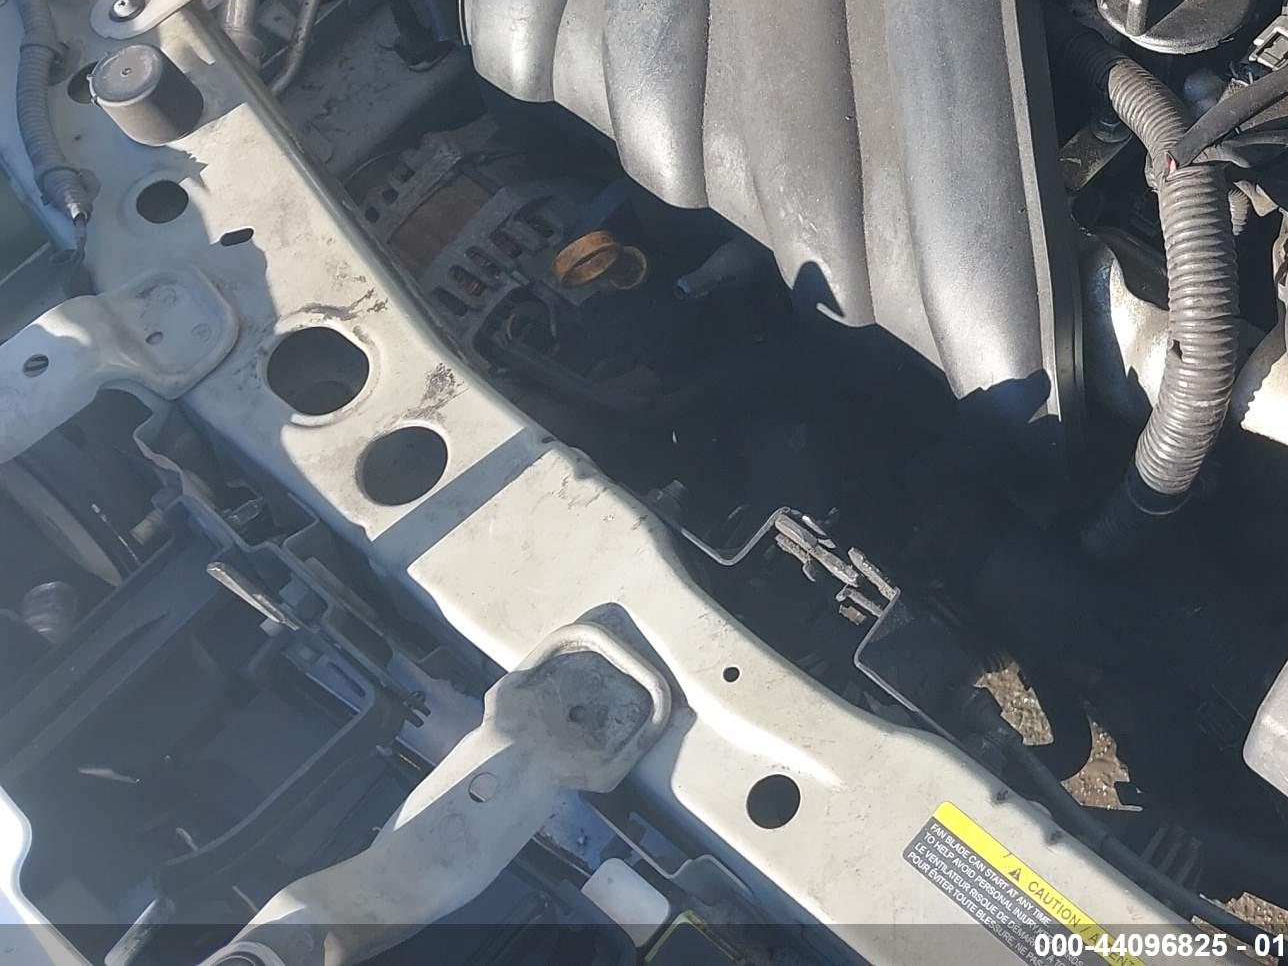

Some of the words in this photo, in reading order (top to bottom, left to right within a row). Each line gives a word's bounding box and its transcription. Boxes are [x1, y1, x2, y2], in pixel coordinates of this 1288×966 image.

[905, 850, 931, 874] POUR
[926, 866, 956, 894] ÉVITER
[950, 888, 978, 913] TOUTE
[1013, 940, 1029, 956] NE
[913, 840, 927, 855] LE
[922, 849, 972, 892] VENTILATEUR
[967, 886, 999, 915] RISQUE
[994, 909, 1010, 924] DE
[921, 831, 936, 846] TO
[932, 839, 955, 861] HELP
[950, 855, 977, 880] AVOID
[972, 873, 1015, 912] PERSONAL
[929, 822, 947, 840] FAN
[943, 834, 970, 859] BLADE
[966, 853, 986, 872] CAN
[982, 867, 1010, 892] START
[1005, 886, 1018, 899] AT
[1014, 894, 1034, 912] ANY
[1025, 879, 1082, 929] CAUTION
